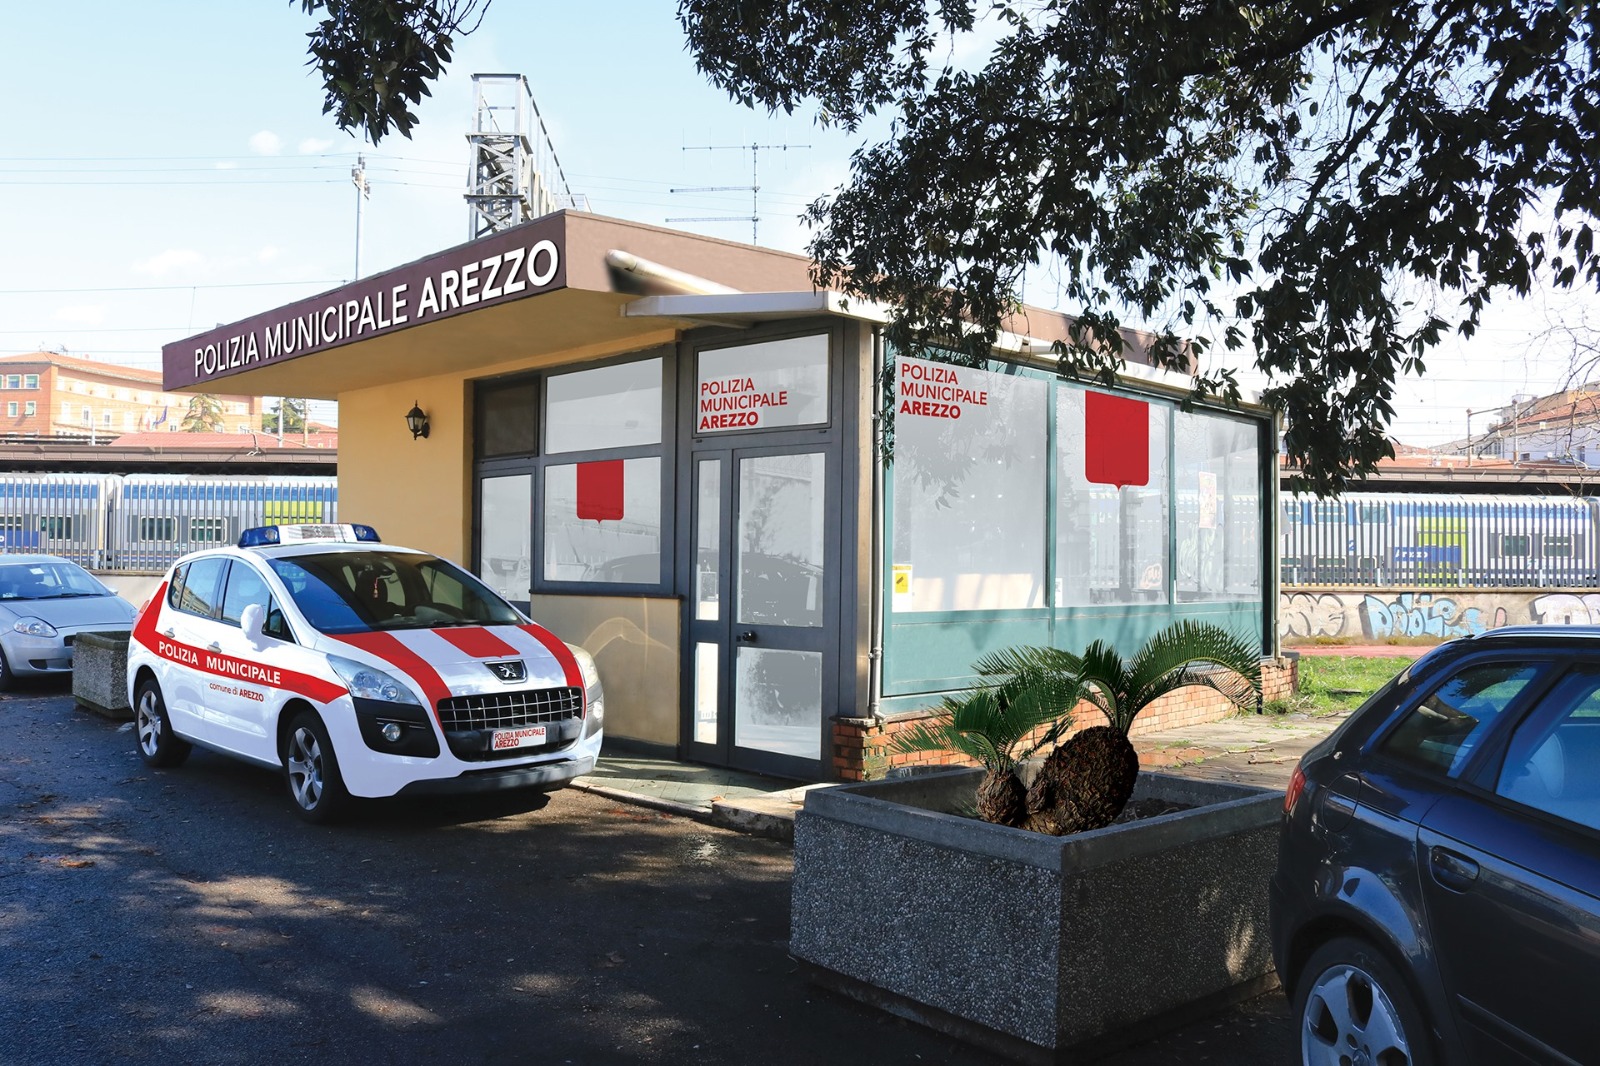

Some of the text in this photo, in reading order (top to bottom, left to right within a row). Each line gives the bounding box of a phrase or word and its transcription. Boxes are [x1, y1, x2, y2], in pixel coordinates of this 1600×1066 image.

[195, 239, 559, 377] POLIZIA MUNICIPALE AREZZO
[901, 363, 958, 385] POLIZIA
[701, 377, 755, 396] POLIZIA
[901, 381, 987, 405] MUNICIPALE
[701, 391, 788, 413] MUNICIPALE
[900, 400, 961, 419] AREZZO
[700, 411, 759, 430] AREZZO
[158, 640, 281, 685] POLIZIA MUNICIPALE
[209, 682, 265, 703] comune di AREZZO
[494, 727, 545, 741] POLIZIA MUNICIPALE
[494, 737, 520, 749] AREZZO
